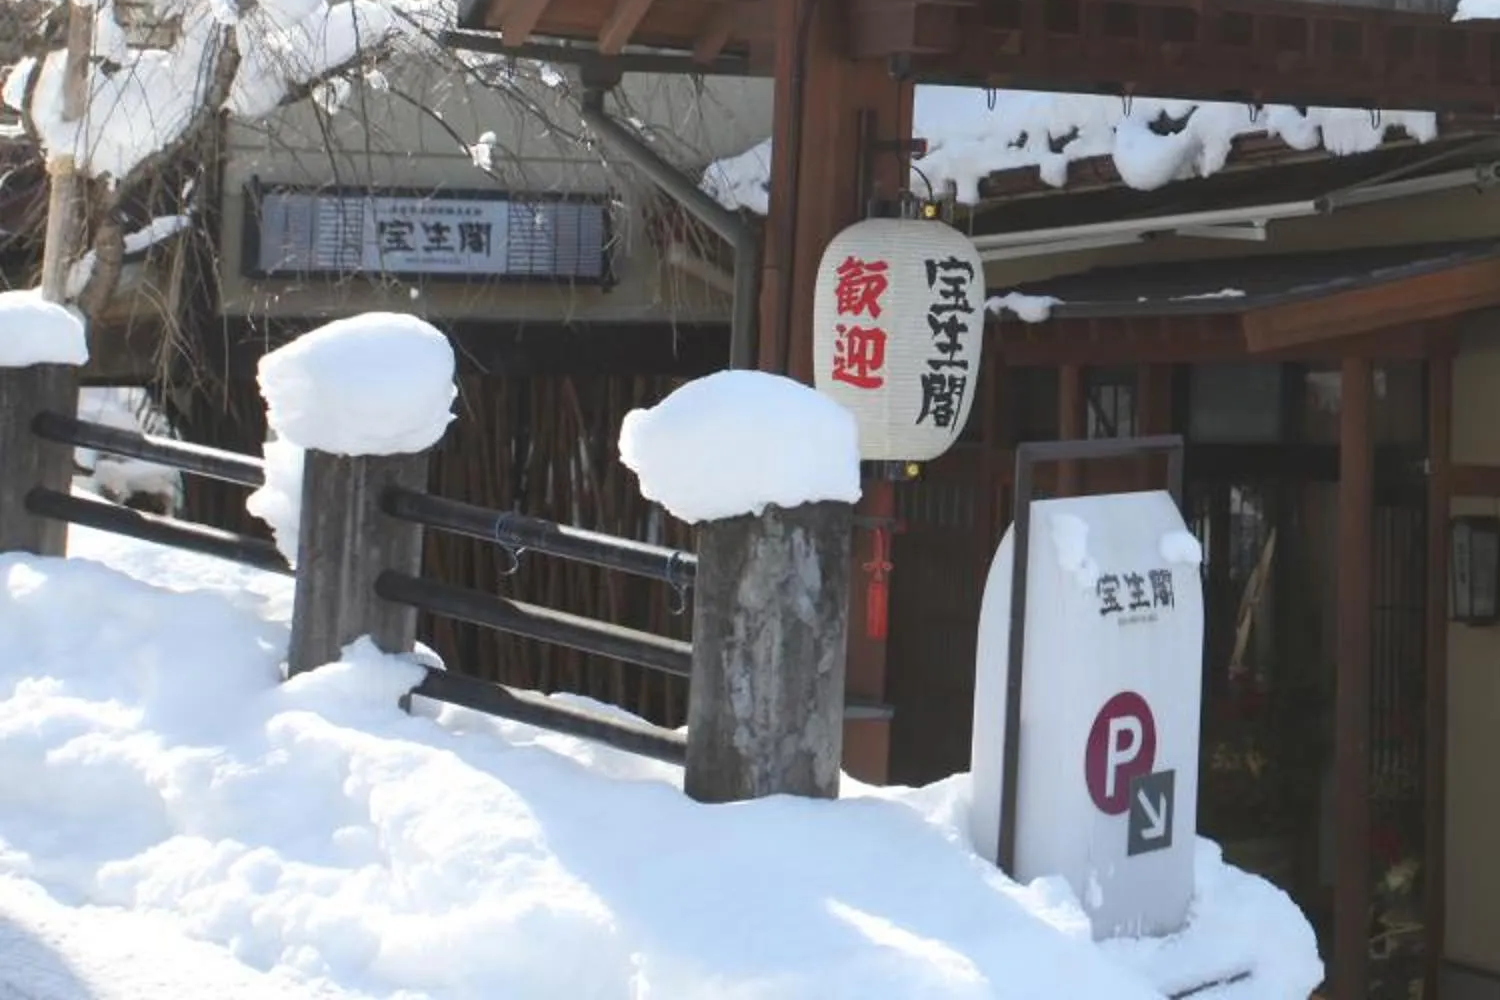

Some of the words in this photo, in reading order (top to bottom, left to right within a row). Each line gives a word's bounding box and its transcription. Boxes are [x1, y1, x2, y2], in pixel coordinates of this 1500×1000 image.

[378, 219, 492, 257] 宝生閣
[832, 256, 889, 389] 歓迎
[914, 256, 974, 432] 宝生閣
[1096, 568, 1175, 616] 宝生閣
[1105, 715, 1143, 798] P
